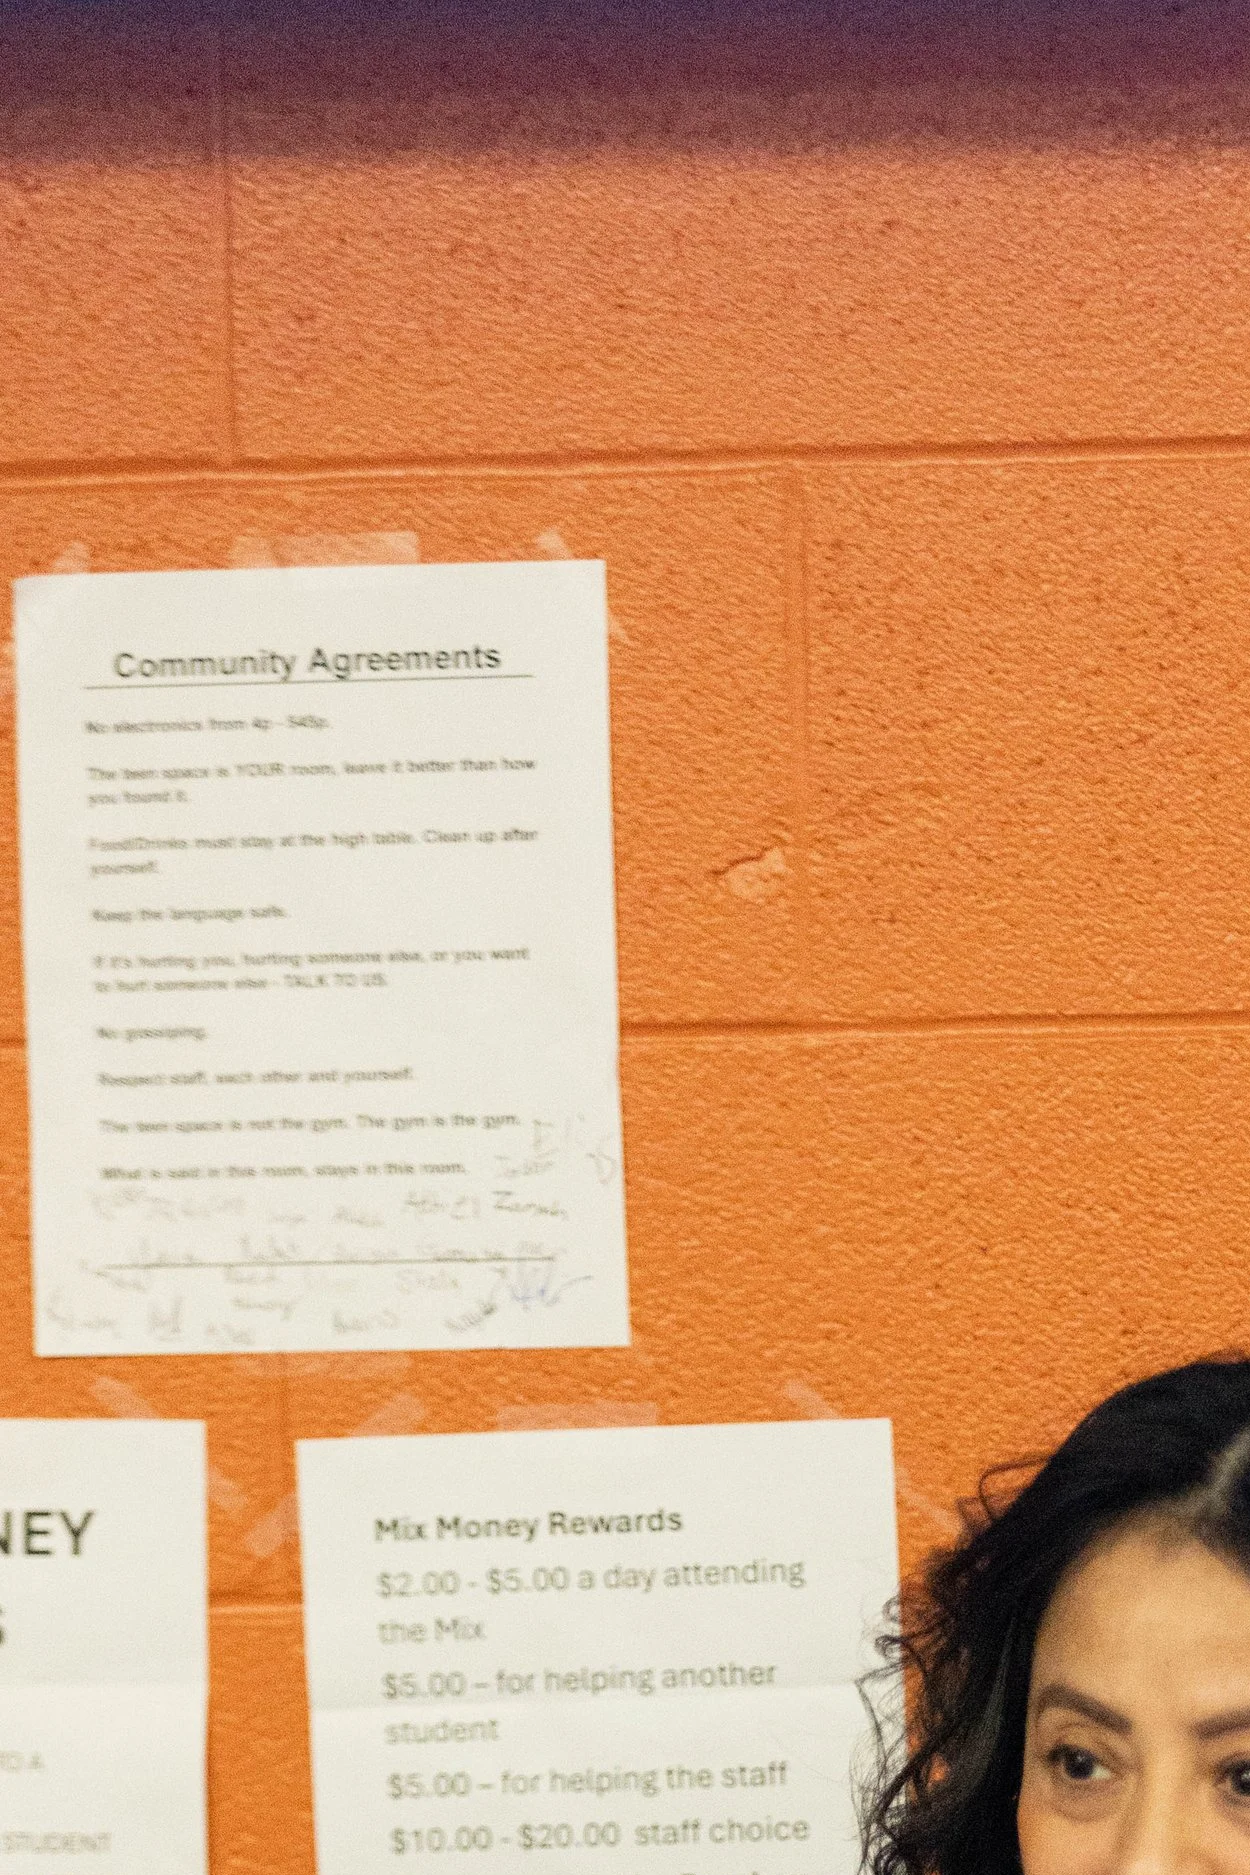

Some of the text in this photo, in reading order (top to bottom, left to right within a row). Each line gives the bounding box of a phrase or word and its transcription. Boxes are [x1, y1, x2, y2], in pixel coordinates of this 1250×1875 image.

[113, 645, 502, 684] Community Agreements
[374, 1506, 683, 1541] Mix Money Rewards
[377, 1570, 461, 1599] $2.00
[486, 1566, 571, 1594] $5.00
[577, 1570, 596, 1591] a
[603, 1564, 657, 1594] day
[663, 1560, 807, 1589] attending
[377, 1615, 485, 1644] the Mix
[381, 1672, 467, 1700] $5.00
[495, 1667, 535, 1695] for
[544, 1667, 656, 1698] helping
[661, 1663, 777, 1689] another
[384, 1718, 500, 1744] student
[387, 1772, 472, 1799] $5.00
[501, 1768, 541, 1795] for
[549, 1767, 660, 1800] helping
[665, 1765, 714, 1790] the
[721, 1760, 789, 1787] staff
[390, 1826, 494, 1854] $10.00
[517, 1821, 621, 1850] $20.00
[635, 1818, 702, 1845] staff
[708, 1818, 810, 1843] choice
